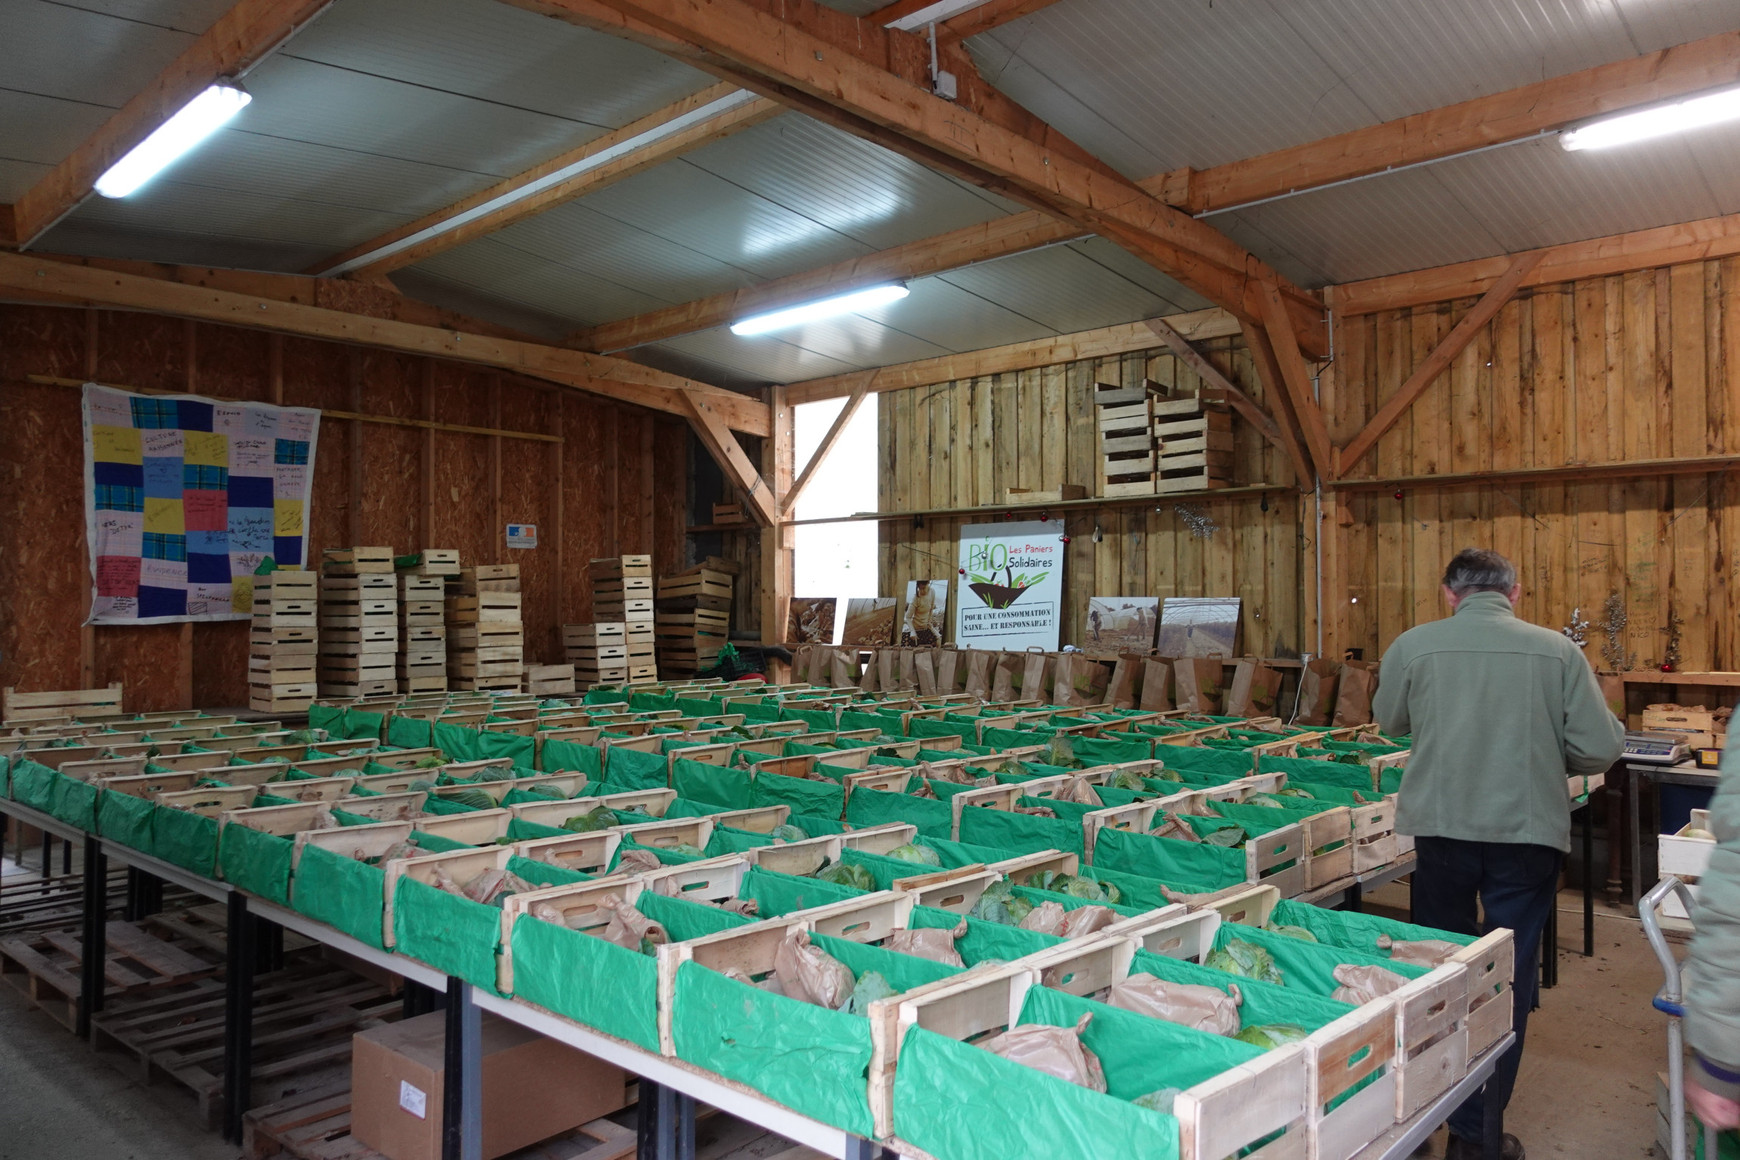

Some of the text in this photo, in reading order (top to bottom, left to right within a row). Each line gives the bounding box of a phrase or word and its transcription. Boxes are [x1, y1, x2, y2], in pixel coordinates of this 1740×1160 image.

[1009, 544, 1053, 554] Les Paniers
[1009, 556, 1053, 568] Solidaires
[997, 609, 1052, 619] CONSOMMATION
